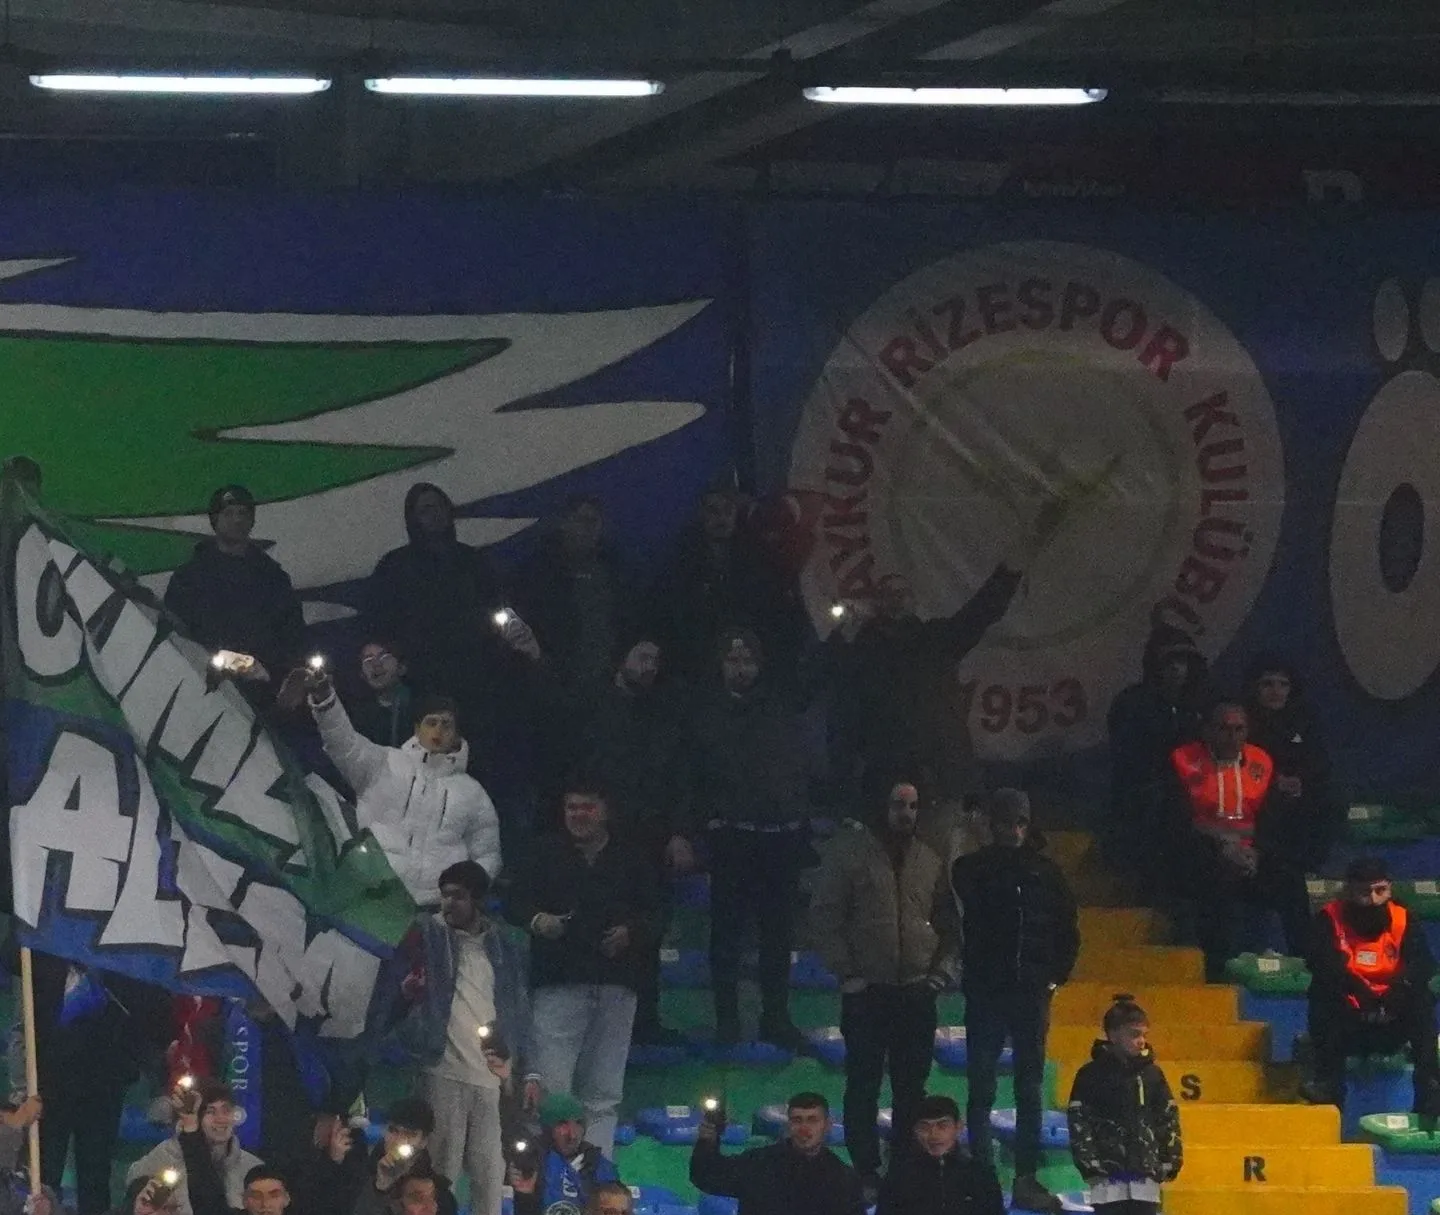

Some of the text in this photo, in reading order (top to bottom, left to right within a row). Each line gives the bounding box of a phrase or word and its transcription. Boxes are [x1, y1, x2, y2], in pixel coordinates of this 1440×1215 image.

[823, 395, 892, 600] AYKUR
[879, 277, 1190, 387] RİZESPOR
[1180, 1073, 1202, 1101] S
[1243, 1155, 1267, 1182] R
